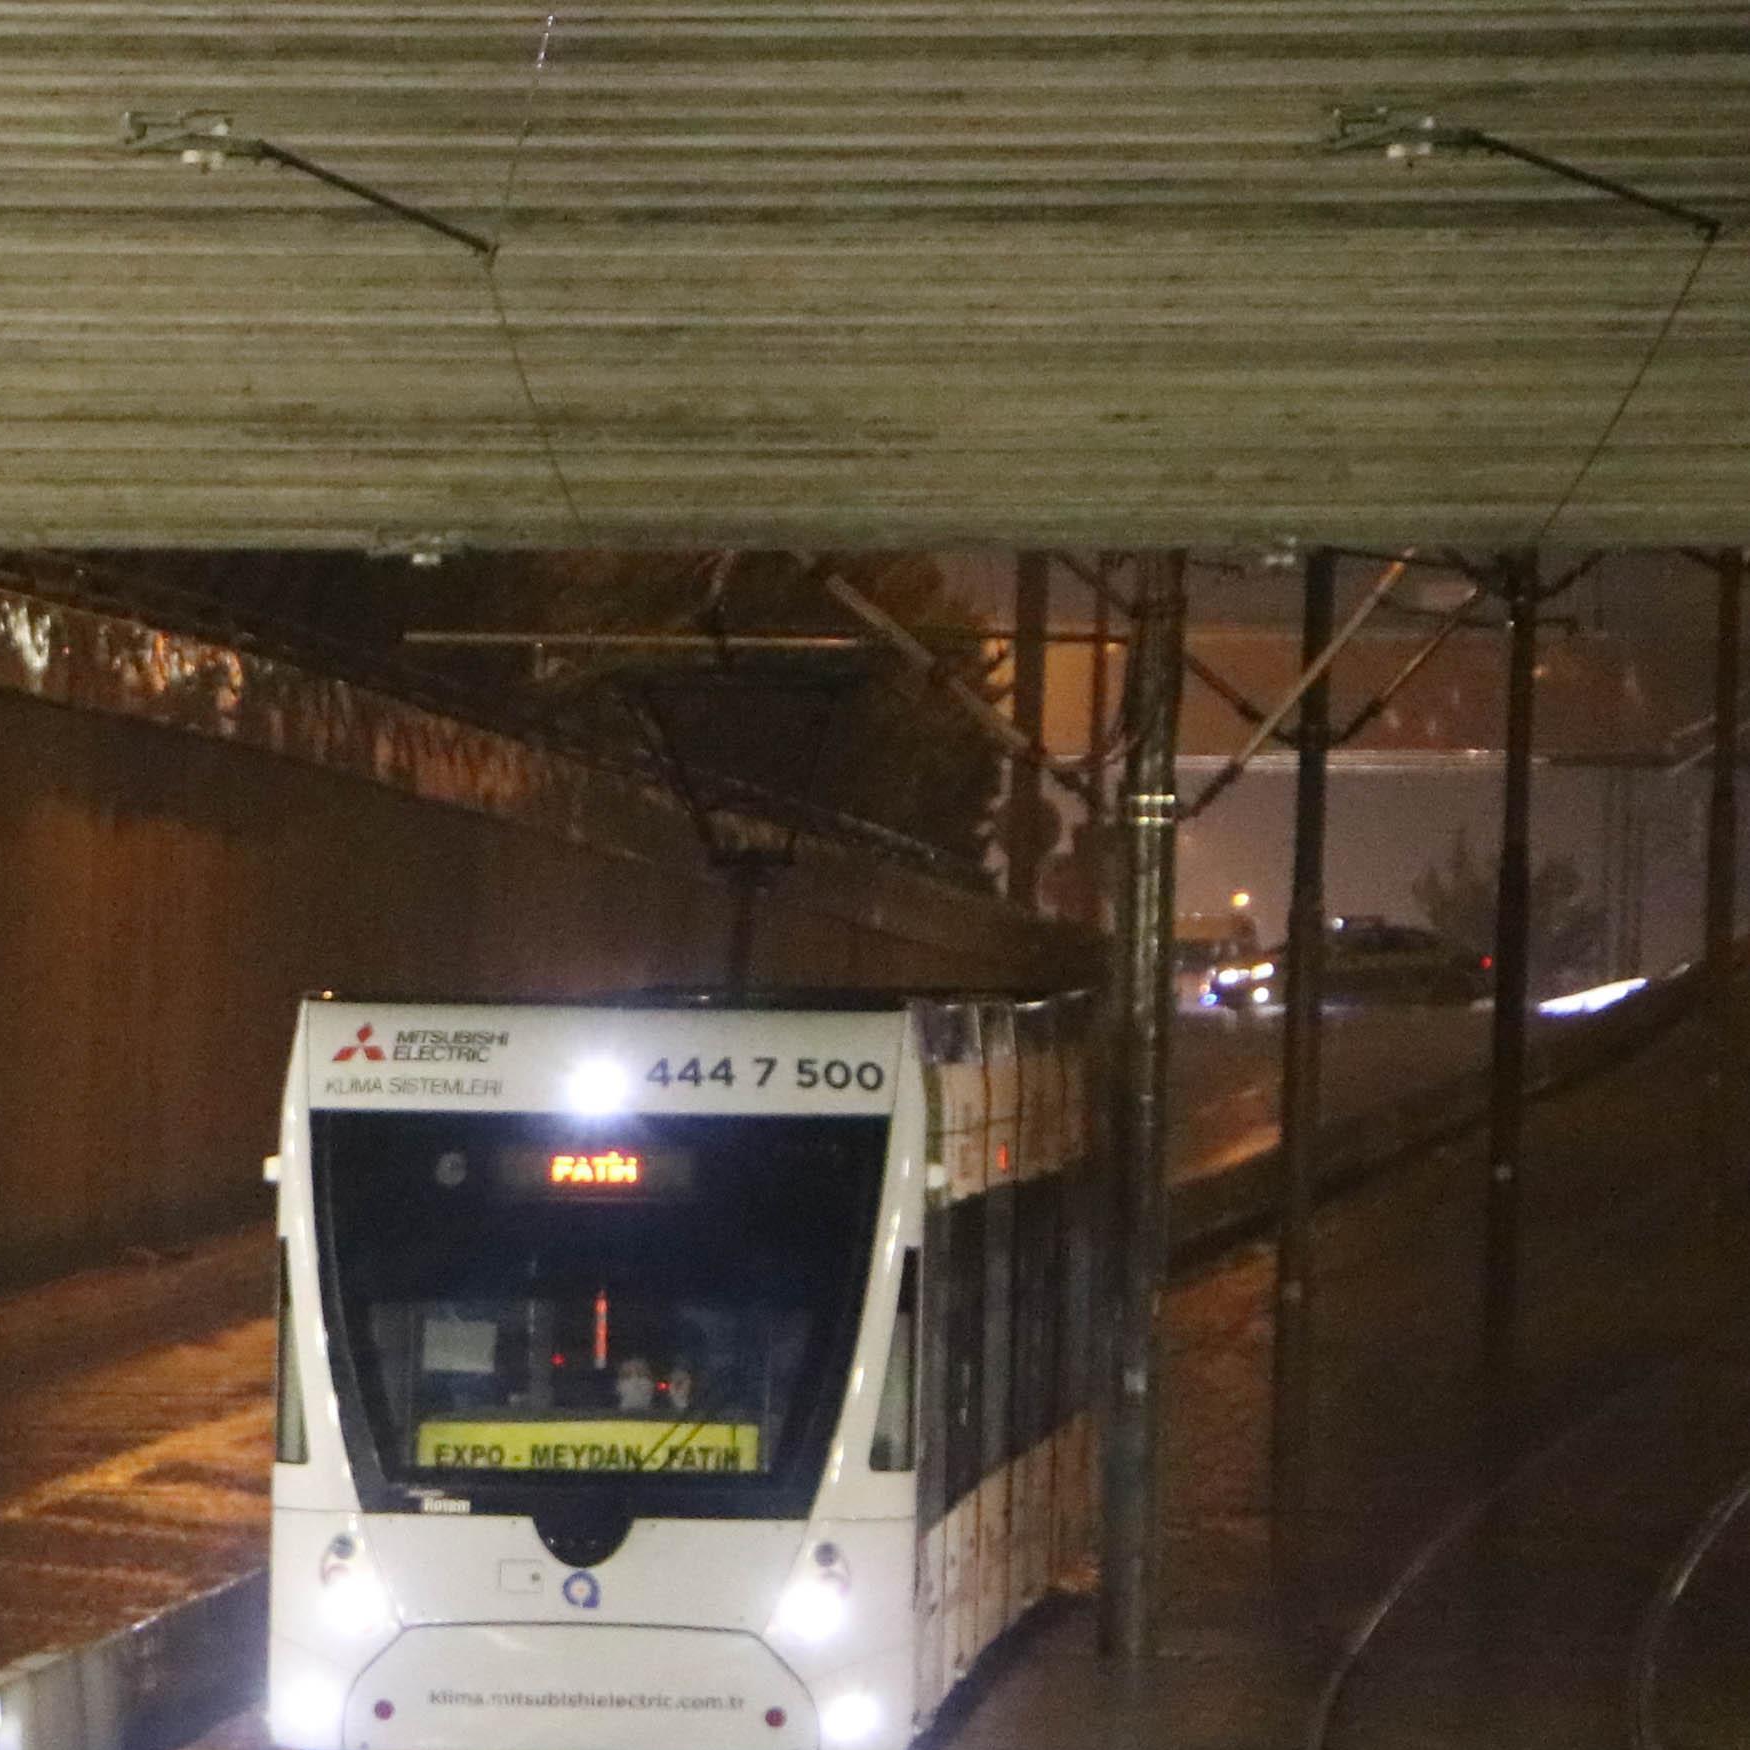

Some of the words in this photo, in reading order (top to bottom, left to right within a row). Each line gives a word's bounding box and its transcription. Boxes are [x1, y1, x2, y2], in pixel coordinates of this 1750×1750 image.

[396, 1030, 510, 1046] MITSUBISHI
[393, 1046, 492, 1062] ELECTRIC
[647, 1057, 736, 1089] 444
[753, 1056, 779, 1088] 7
[795, 1058, 886, 1092] 500
[435, 1443, 506, 1468] EXPO
[530, 1443, 644, 1471] MEYDAN
